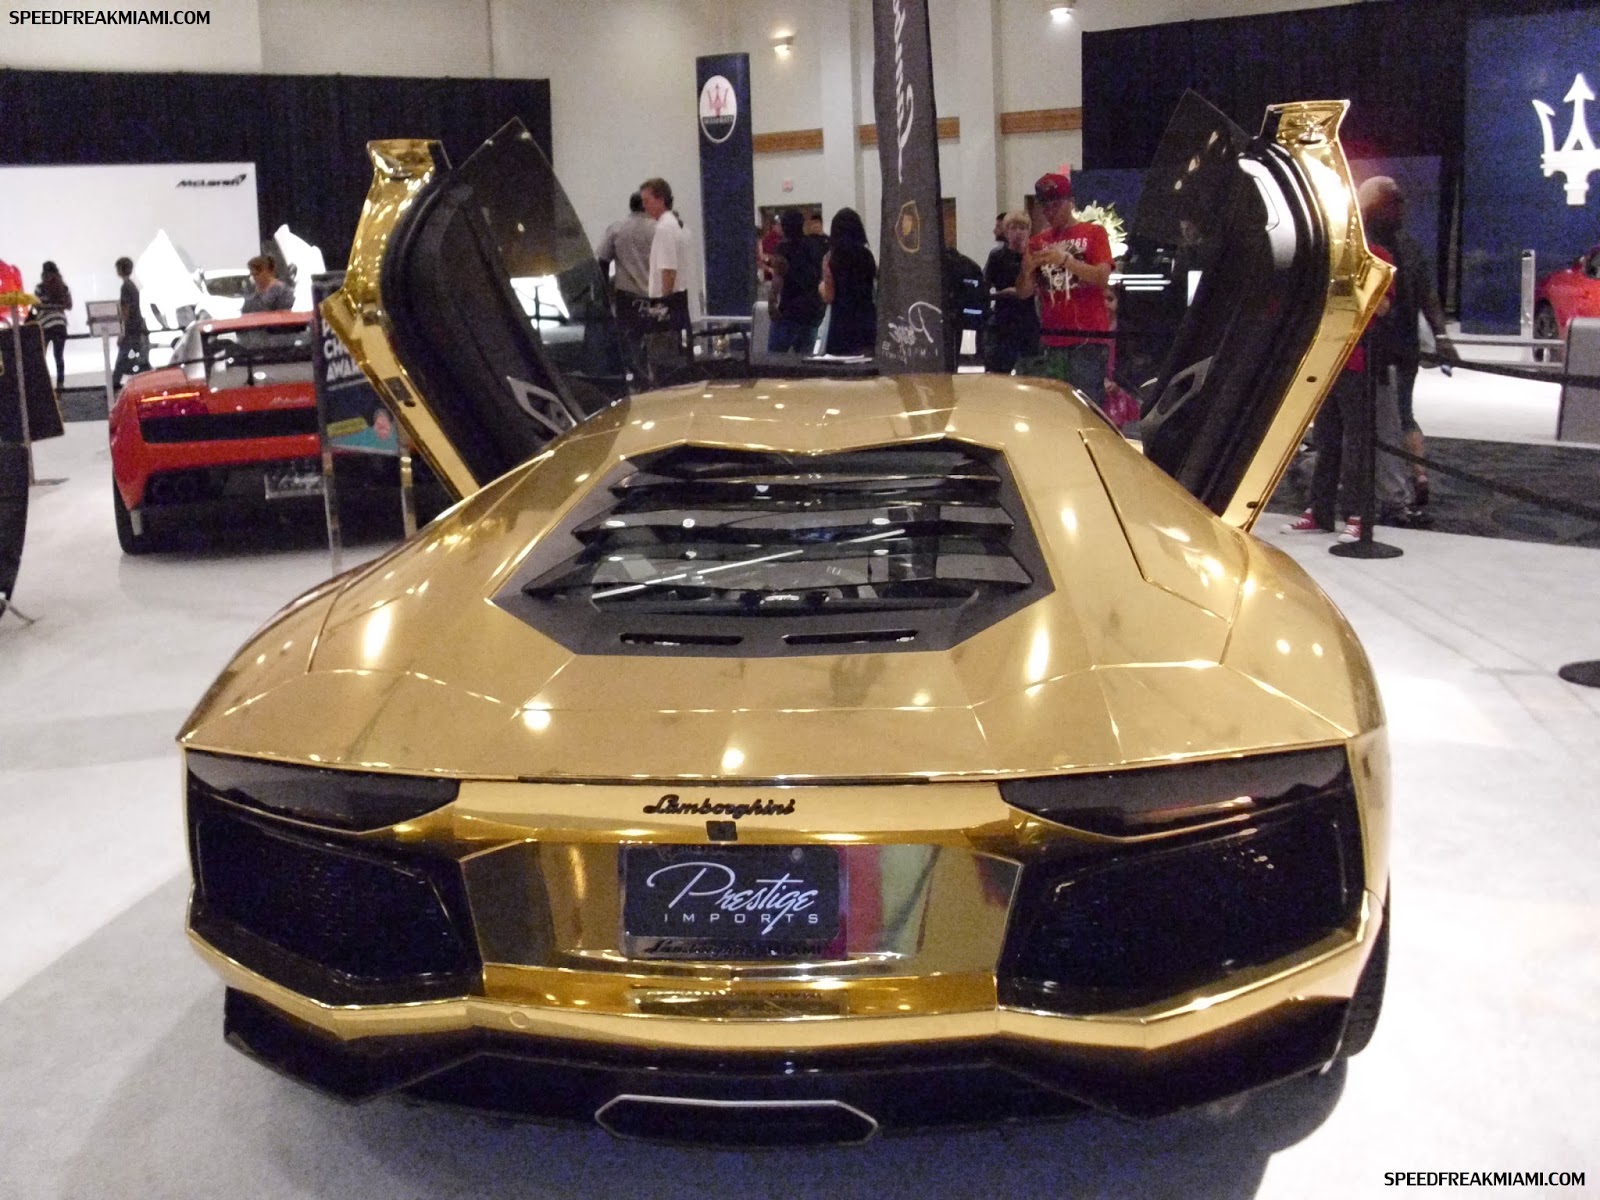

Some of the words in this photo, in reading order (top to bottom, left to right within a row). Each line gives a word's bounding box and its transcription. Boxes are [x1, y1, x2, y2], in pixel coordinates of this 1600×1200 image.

[643, 794, 796, 819] Lamborghini
[646, 861, 819, 936] Prestige
[664, 912, 819, 924] IMPORTS
